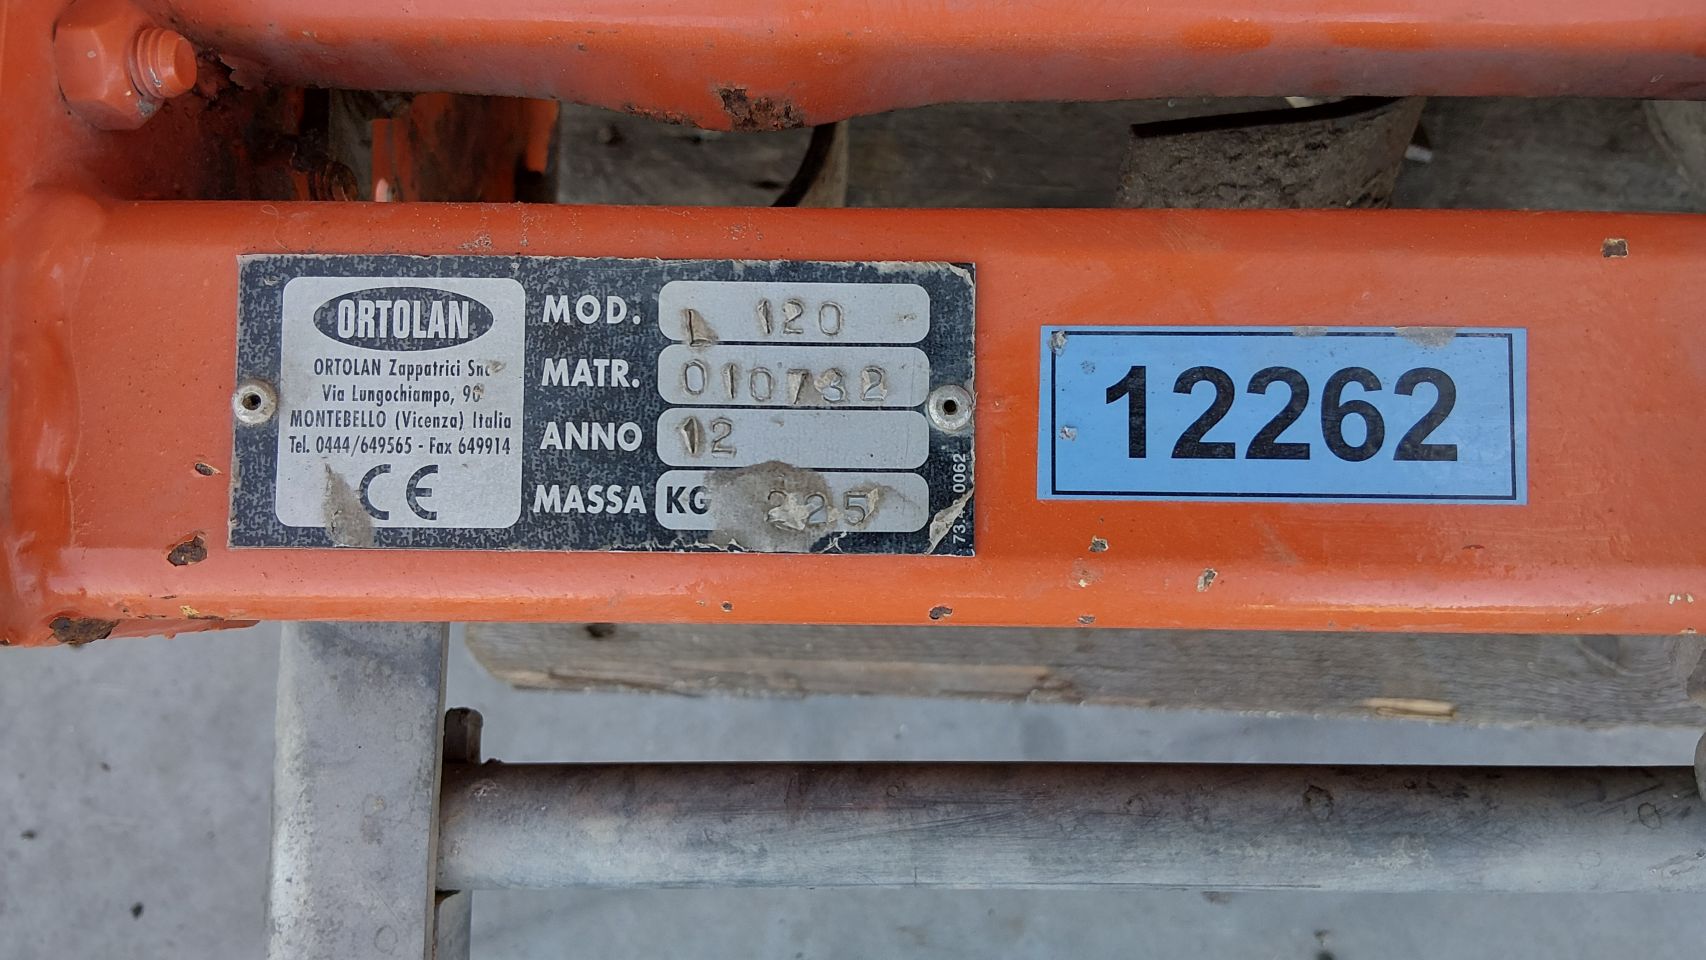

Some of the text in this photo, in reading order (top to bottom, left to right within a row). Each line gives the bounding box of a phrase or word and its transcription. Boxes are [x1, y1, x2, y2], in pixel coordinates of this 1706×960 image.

[337, 299, 470, 339] ORTOLAN
[542, 294, 641, 325] MOD.
[756, 299, 844, 337] 120
[313, 357, 381, 377] ORTOLAN
[388, 359, 461, 382] Zappatrici
[541, 358, 640, 388] MATR.
[322, 384, 345, 402] Via
[352, 384, 455, 408] Lungochiampo,
[289, 410, 512, 431] MONTEBELLO (Vicenza) Italia
[1105, 364, 1458, 463] 12262
[289, 435, 310, 454] Tel.
[316, 435, 412, 457] 0444/649565
[429, 436, 452, 454] Fax
[458, 437, 511, 455] 649914
[540, 421, 643, 452] ANNO
[533, 484, 647, 515] MASSA
[666, 485, 712, 515] KG
